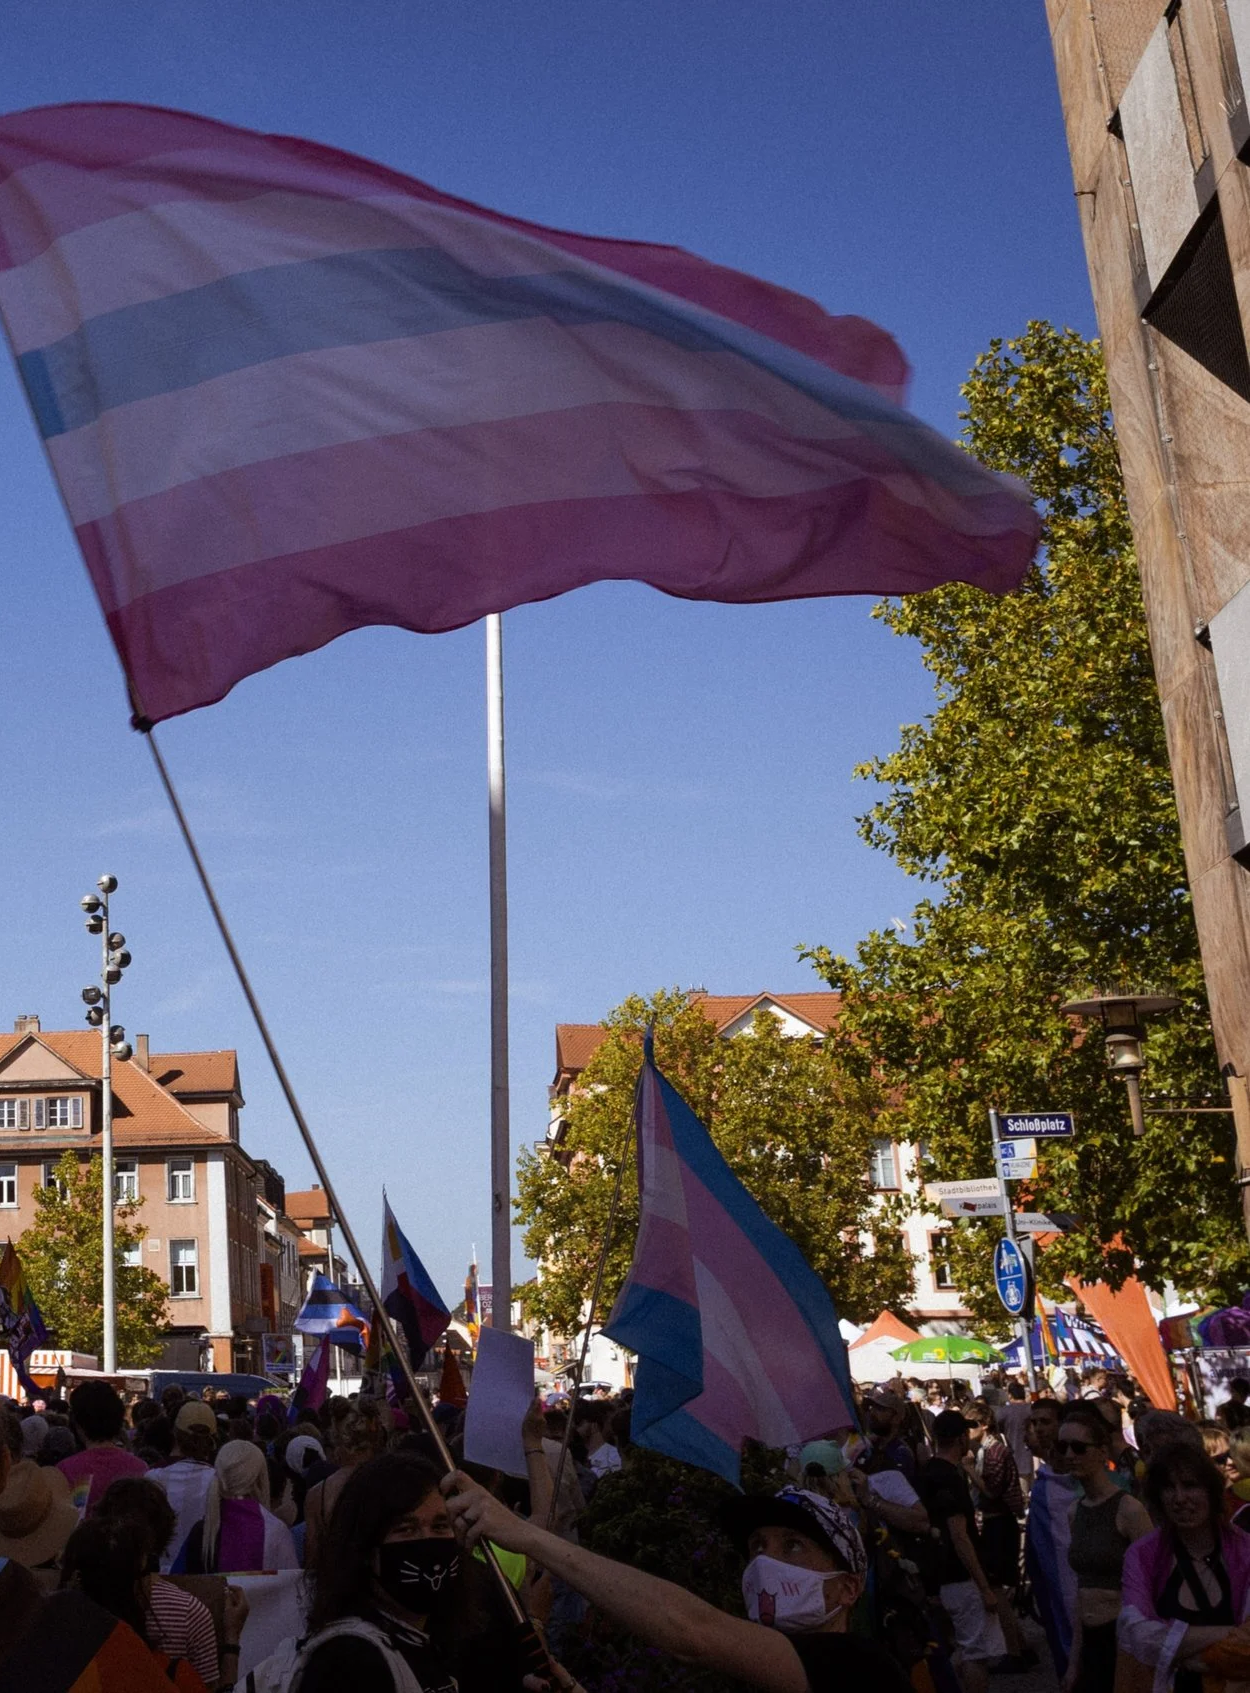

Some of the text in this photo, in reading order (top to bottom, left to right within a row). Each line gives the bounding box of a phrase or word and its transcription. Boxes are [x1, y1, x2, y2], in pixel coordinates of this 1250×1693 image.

[1007, 1117, 1066, 1133] Schloßplatz
[938, 1184, 998, 1196] Stadtbibliothek
[959, 1202, 997, 1211] Kpalais
